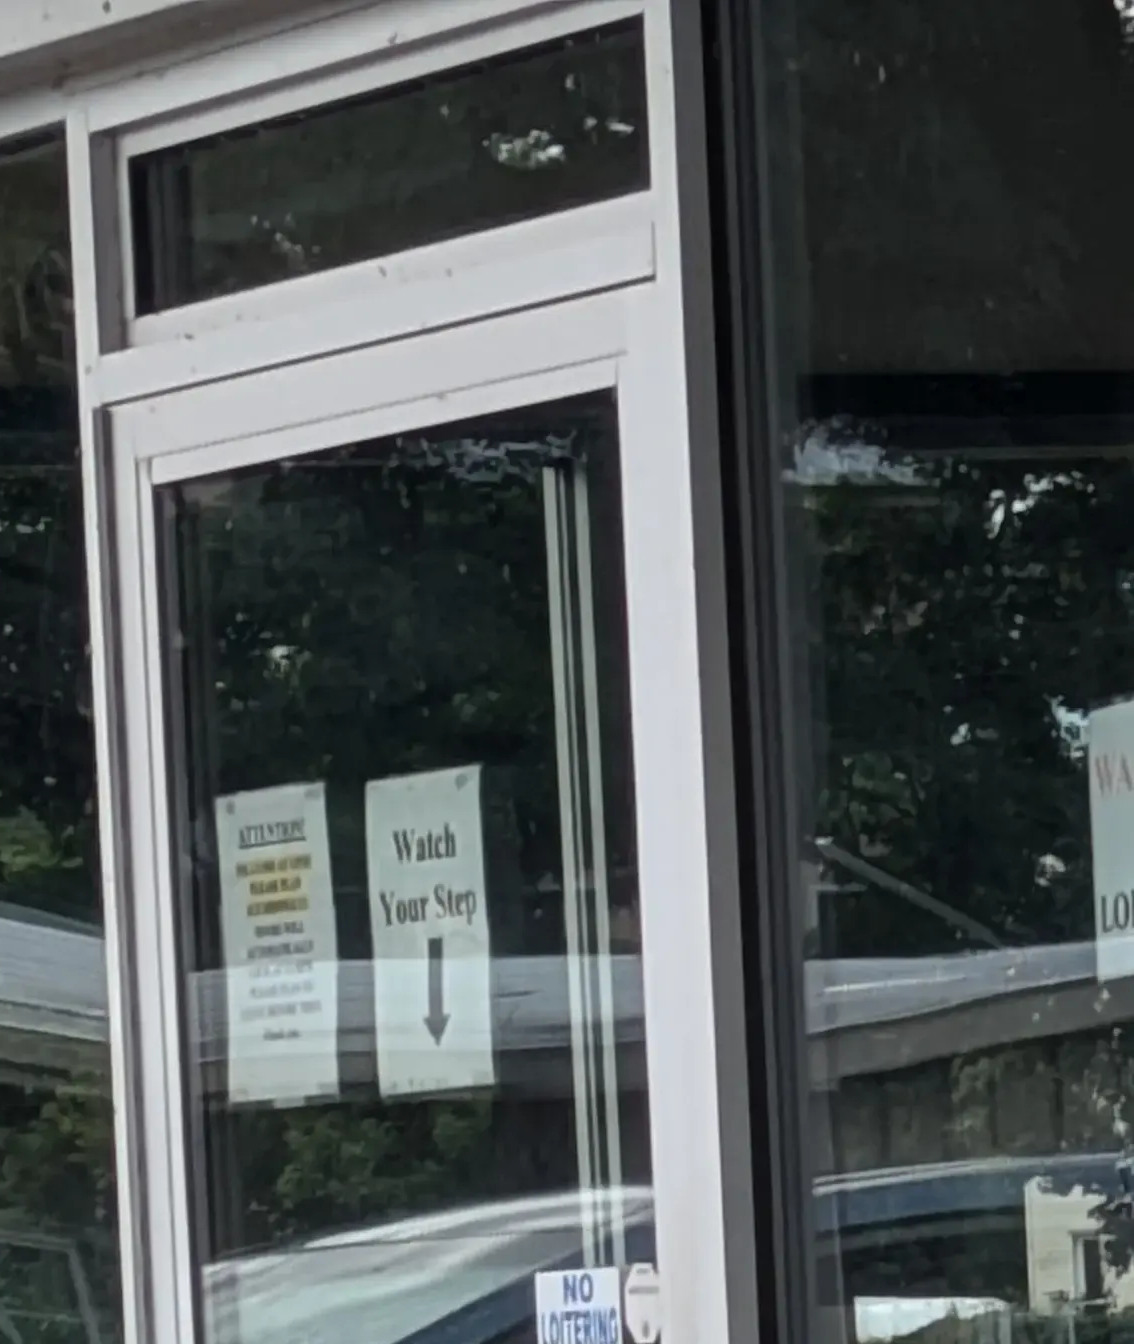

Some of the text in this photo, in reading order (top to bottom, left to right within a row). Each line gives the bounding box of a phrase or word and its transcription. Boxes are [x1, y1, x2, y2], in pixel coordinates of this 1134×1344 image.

[1095, 752, 1134, 795] WA
[392, 821, 457, 864] Watch
[379, 883, 477, 926] Your Step
[562, 1273, 594, 1304] NO
